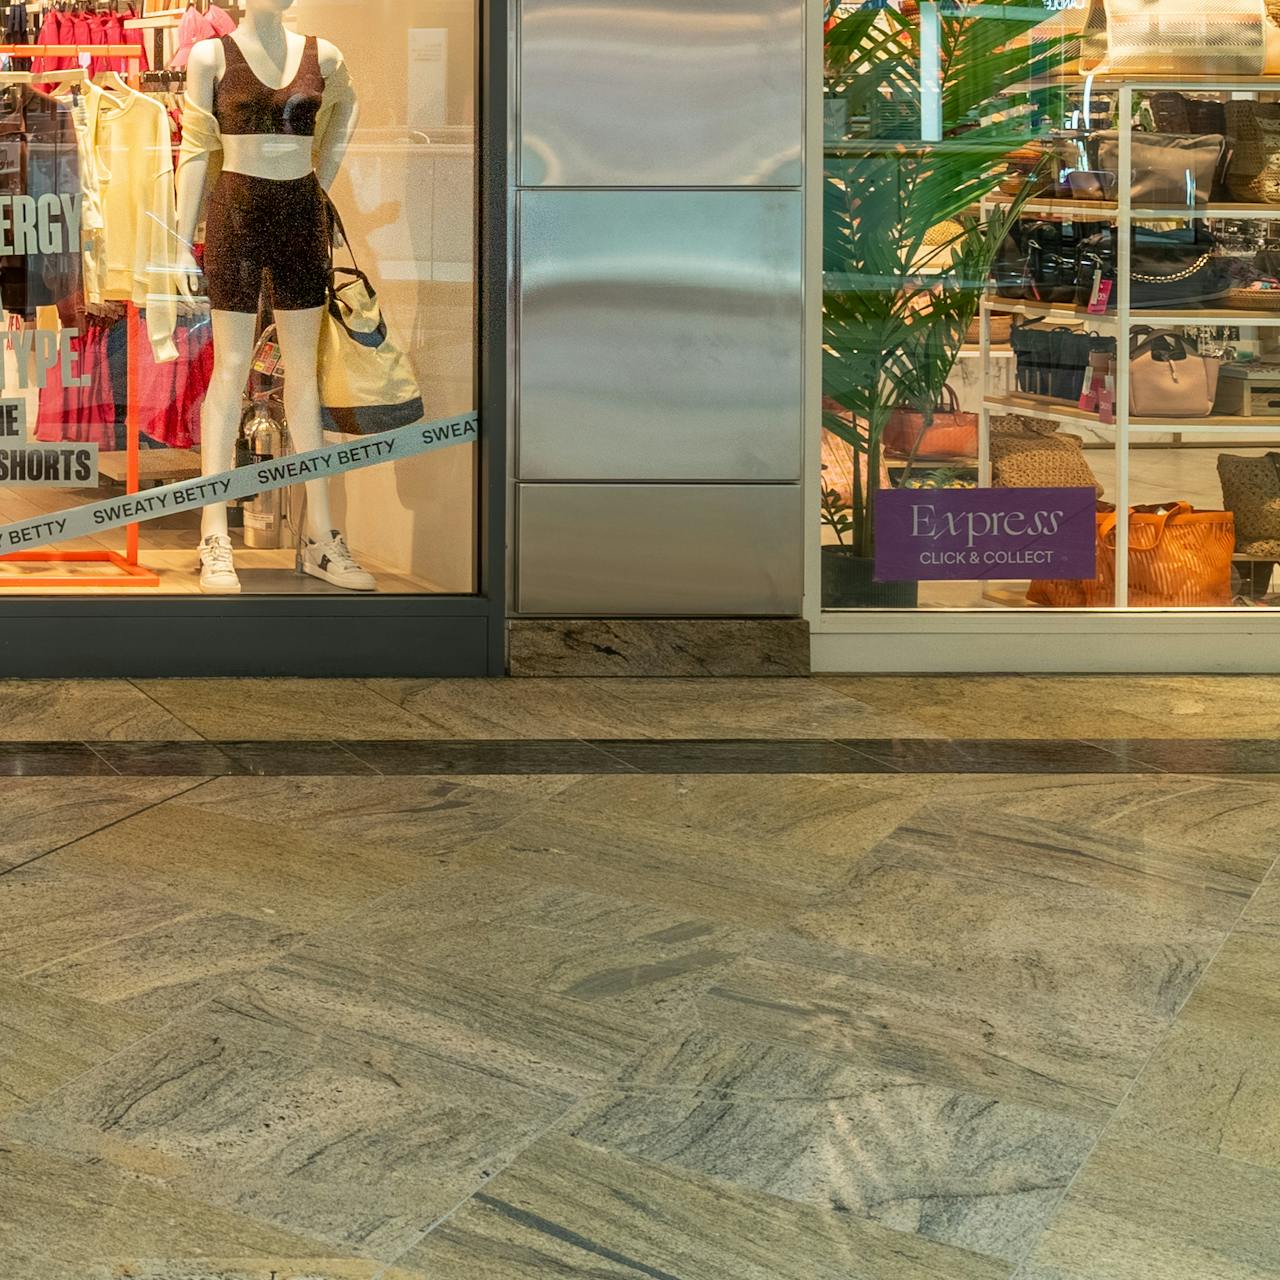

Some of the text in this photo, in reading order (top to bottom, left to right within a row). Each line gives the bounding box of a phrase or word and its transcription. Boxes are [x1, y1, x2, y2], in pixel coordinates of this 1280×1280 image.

[8, 518, 67, 545] BETTY
[93, 493, 168, 525] SWEATY
[172, 478, 231, 505] BETTY
[257, 453, 332, 485] SWEATY
[337, 438, 395, 465] BETTY
[422, 418, 480, 444] SWEA
[909, 504, 1064, 548] Express
[920, 551, 1054, 565] CLICK & COLLECT
